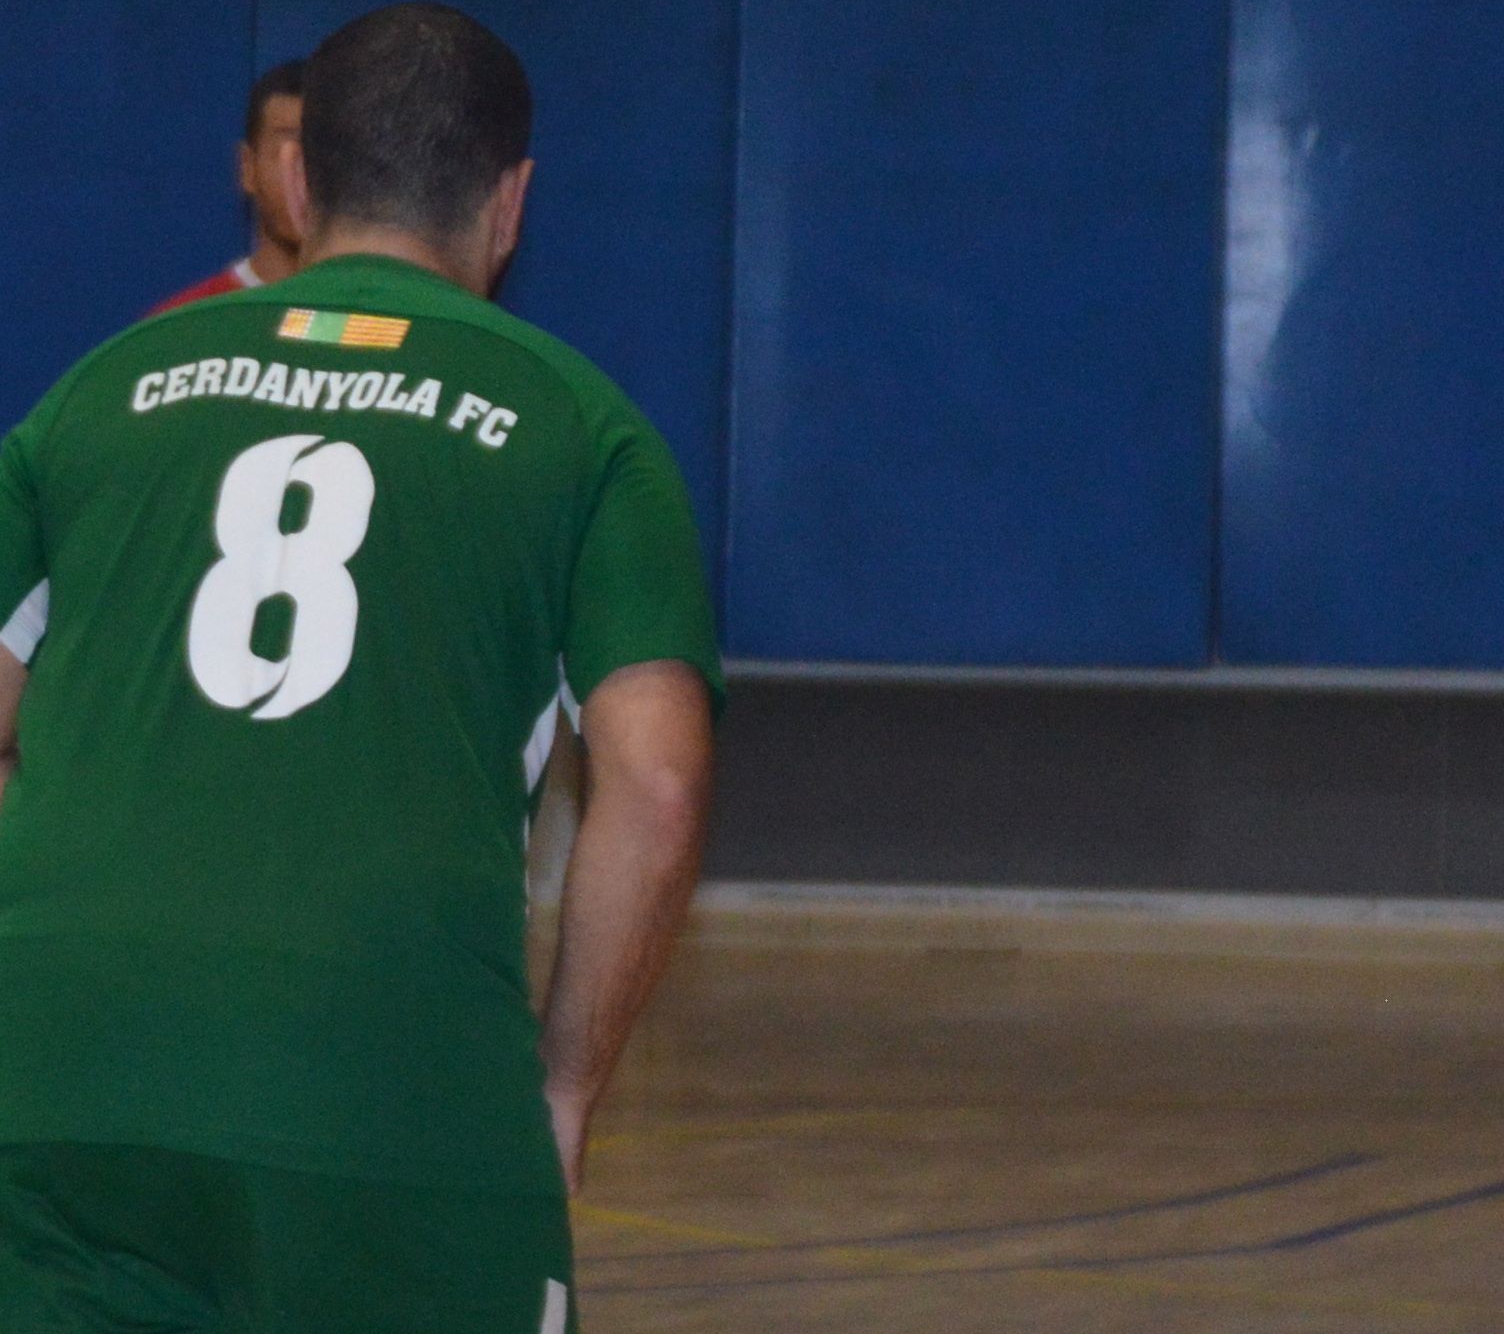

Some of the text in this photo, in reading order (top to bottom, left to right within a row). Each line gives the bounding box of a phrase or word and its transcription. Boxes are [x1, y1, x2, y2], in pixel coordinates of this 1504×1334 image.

[132, 356, 519, 449] CERDANYOLA FC
[188, 433, 376, 721] 8
